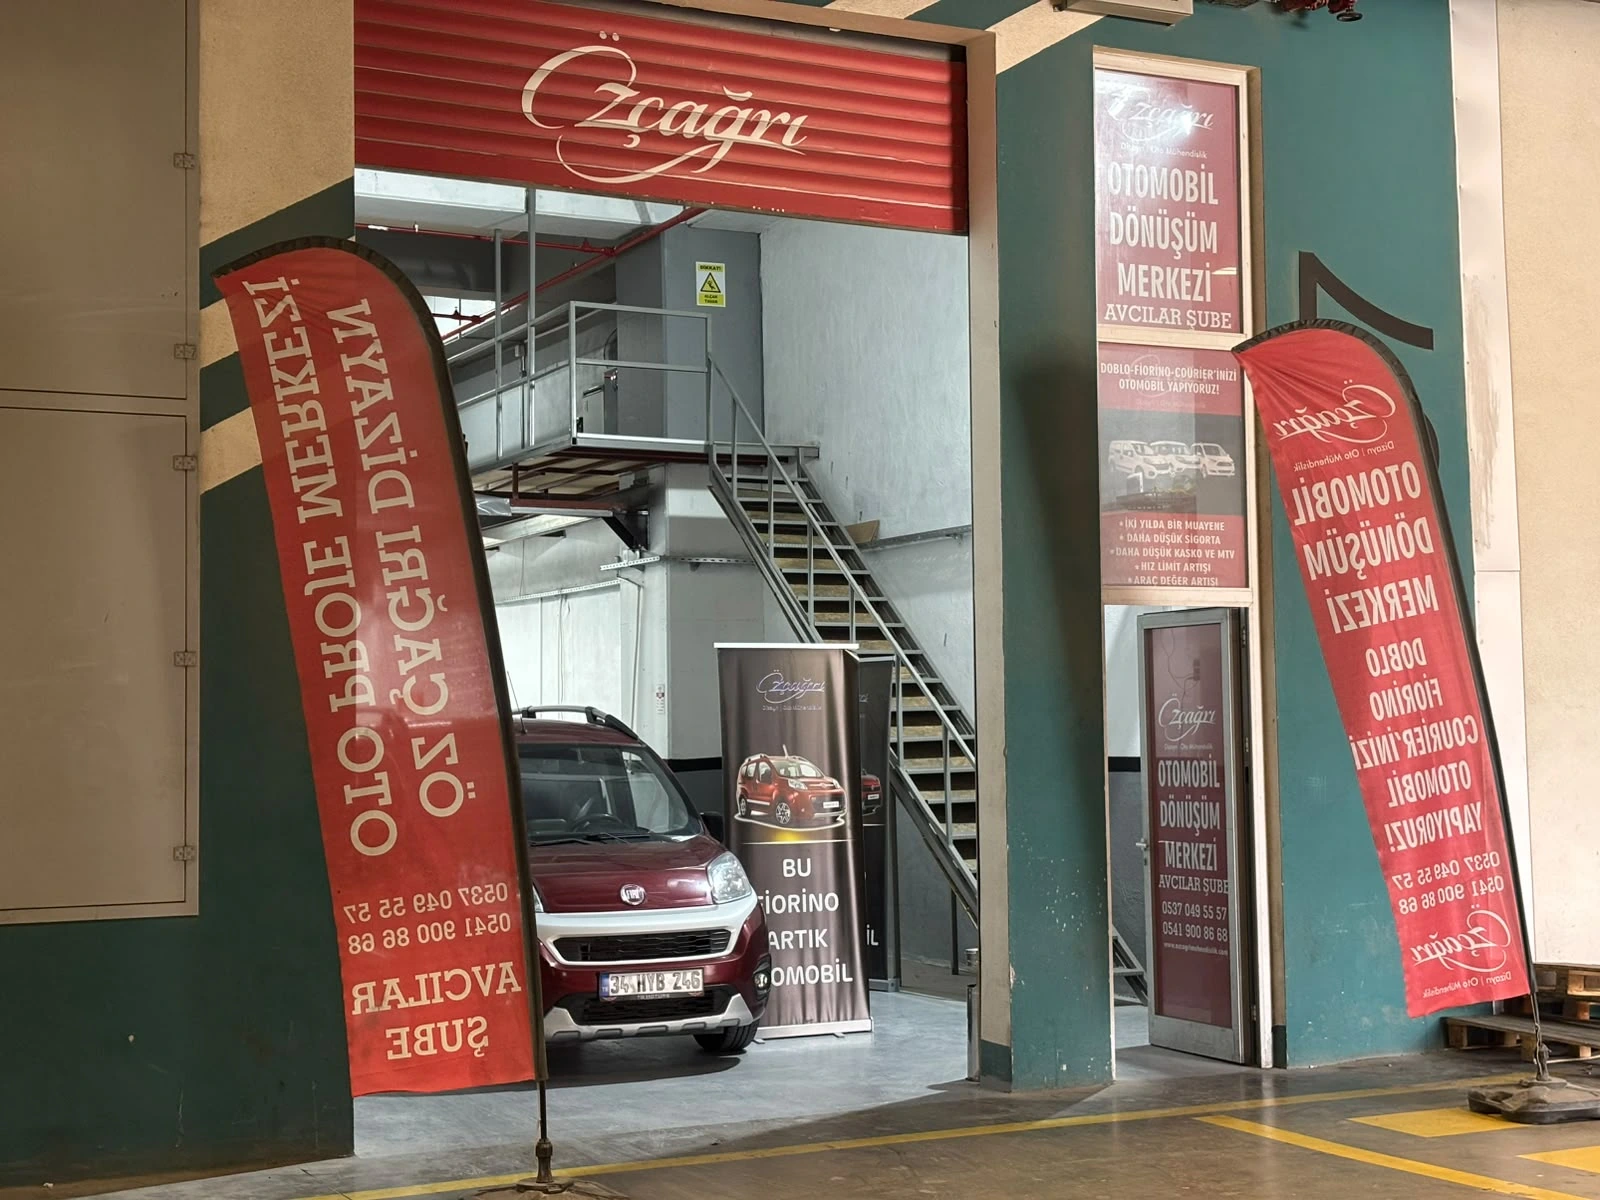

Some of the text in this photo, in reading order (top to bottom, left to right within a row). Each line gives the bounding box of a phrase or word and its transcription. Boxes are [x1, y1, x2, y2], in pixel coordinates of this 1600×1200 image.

[522, 31, 809, 184] Özçağrı
[1108, 161, 1219, 205] OTOMOBİL
[1110, 205, 1218, 260] DÖNÜŞÜM
[1117, 262, 1212, 303] MERKEZİ
[1104, 303, 1232, 331] AVCILAR ŞUBE
[1167, 381, 1220, 395] YAPIYORUZ!
[1140, 519, 1164, 529] YILDA
[1167, 518, 1182, 530] BİR
[1185, 521, 1225, 532] MUAYENE
[1127, 534, 1151, 543] DAHA
[1153, 533, 1182, 545] DÜŞÜK
[1115, 547, 1235, 559] DAHA DÜŞÜK KASKO VE MTV
[1141, 562, 1155, 571] HIZ
[1183, 562, 1211, 574] ARTIŞI
[1160, 574, 1188, 586] DEĞER
[1158, 753, 1220, 788] OTOMOBİL
[1160, 794, 1220, 836] DÖNÜŞÜM
[1164, 837, 1217, 871] MERKEZİ
[782, 858, 811, 878] BU
[1158, 874, 1229, 896] AVCILAR ŞUBE
[1162, 901, 1227, 920] 0537 049 55 57
[768, 928, 828, 950] ARTIK
[1162, 921, 1228, 942] 0541 900 86 68
[610, 971, 701, 994] 34 HYB 246
[771, 958, 853, 987] OMOBİL
